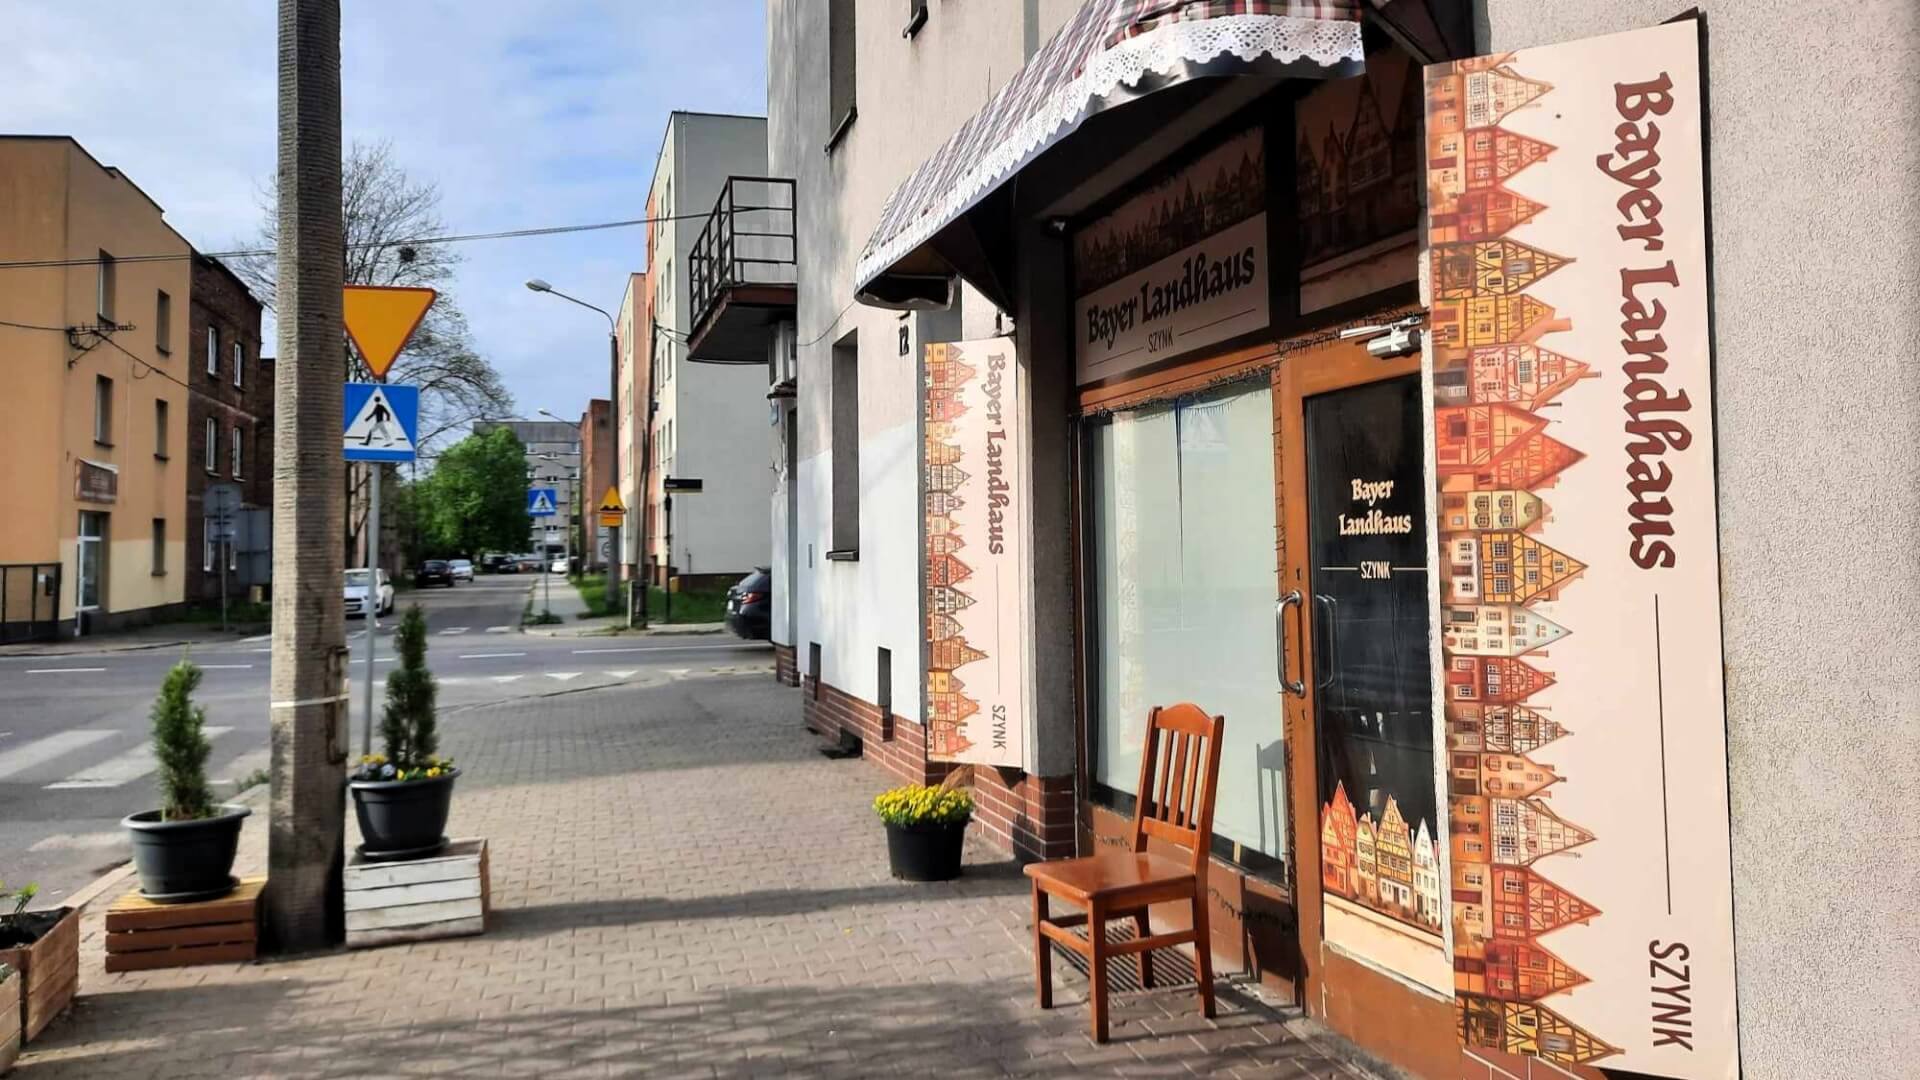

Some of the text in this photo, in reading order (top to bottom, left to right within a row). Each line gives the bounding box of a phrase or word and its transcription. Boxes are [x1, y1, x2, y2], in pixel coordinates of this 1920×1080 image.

[1087, 246, 1256, 351] Bayer Landhaus
[1596, 71, 1692, 569] Bayer Landhaus
[1148, 325, 1174, 353] SZYNK
[981, 352, 1010, 555] Bayer Landhaus
[1351, 478, 1394, 507] Bayer
[1338, 509, 1412, 536] Landhaus
[1360, 561, 1391, 579] SZYNK
[992, 704, 1007, 750] SZYNK
[1648, 939, 1693, 1052] SZYNK
